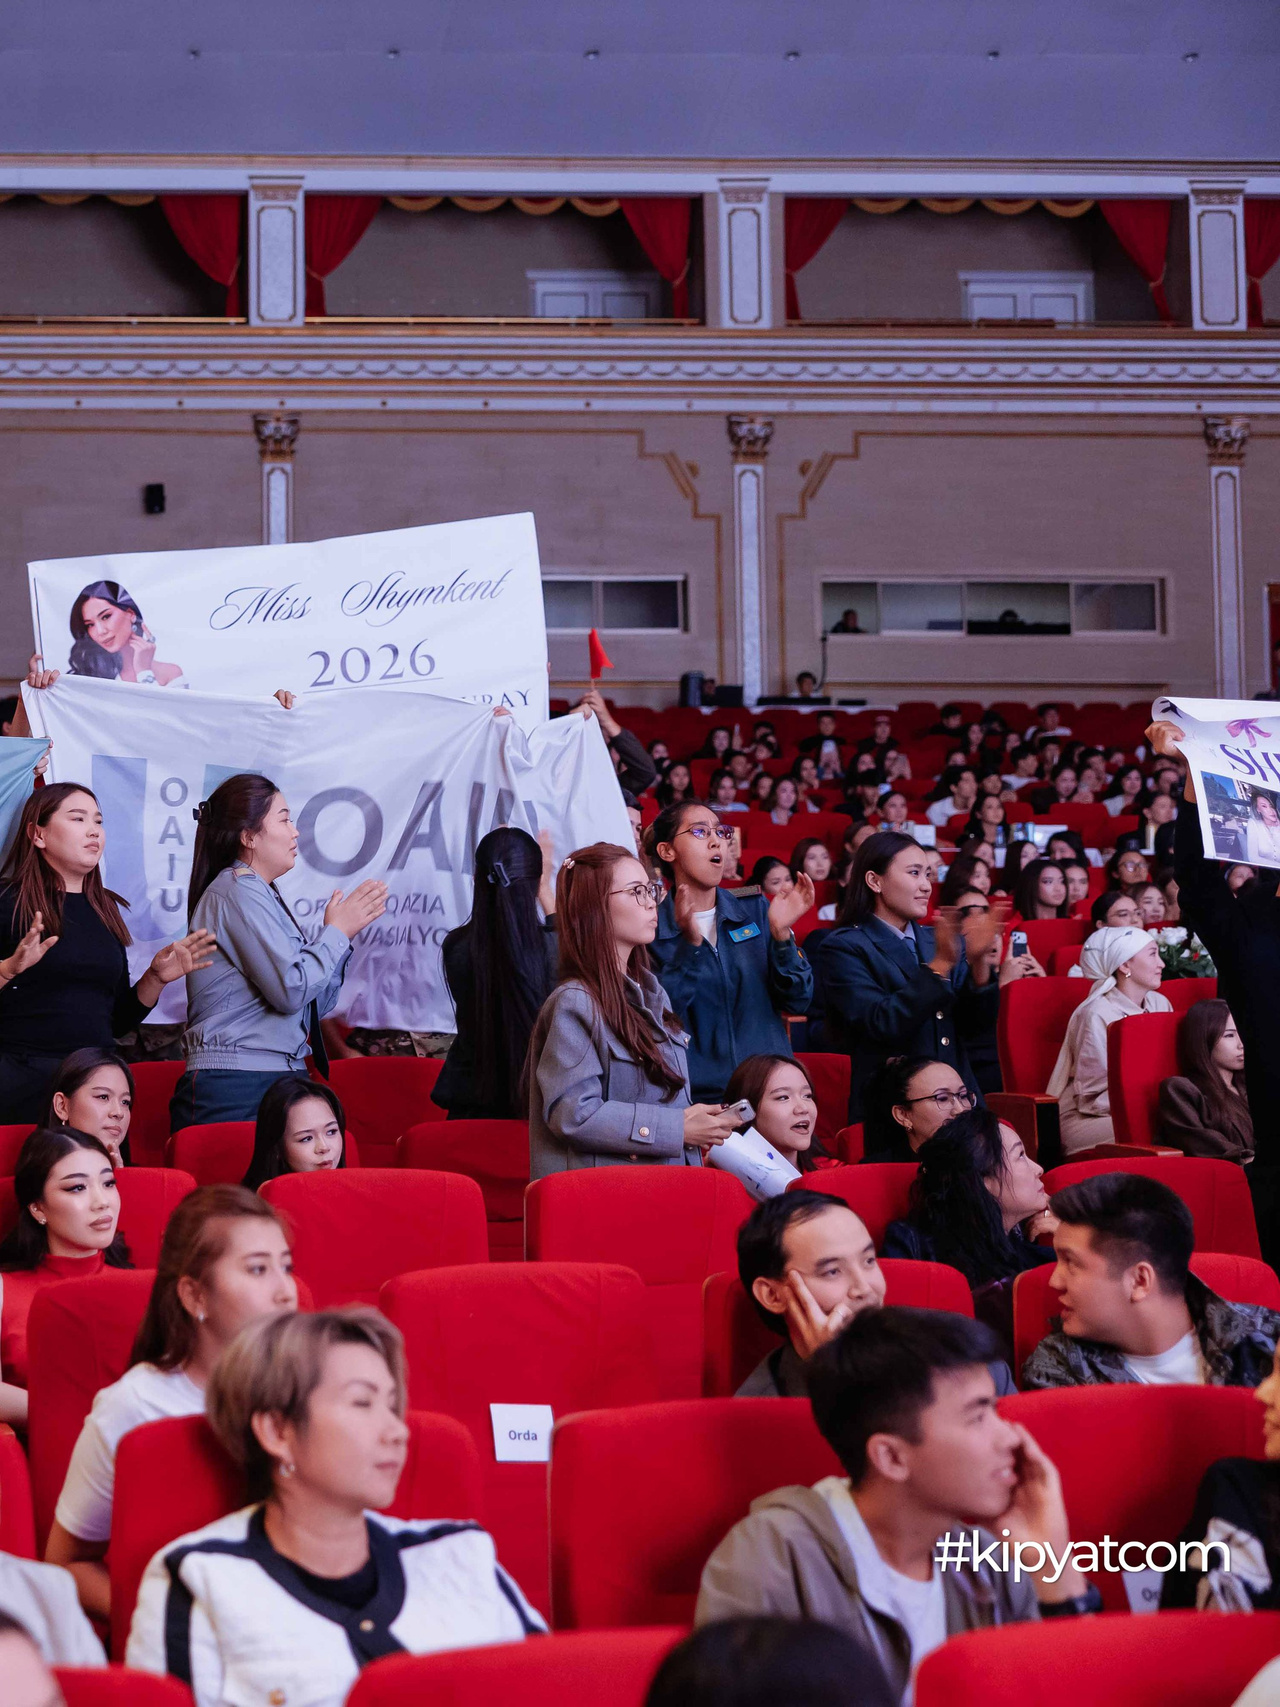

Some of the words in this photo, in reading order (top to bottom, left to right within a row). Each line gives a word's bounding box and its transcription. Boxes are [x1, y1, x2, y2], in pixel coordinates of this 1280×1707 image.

[209, 582, 313, 631] Miss
[340, 568, 514, 628] Shymkent
[306, 638, 437, 689] 2026
[158, 777, 188, 912] OAIU
[508, 1430, 538, 1441] Orda
